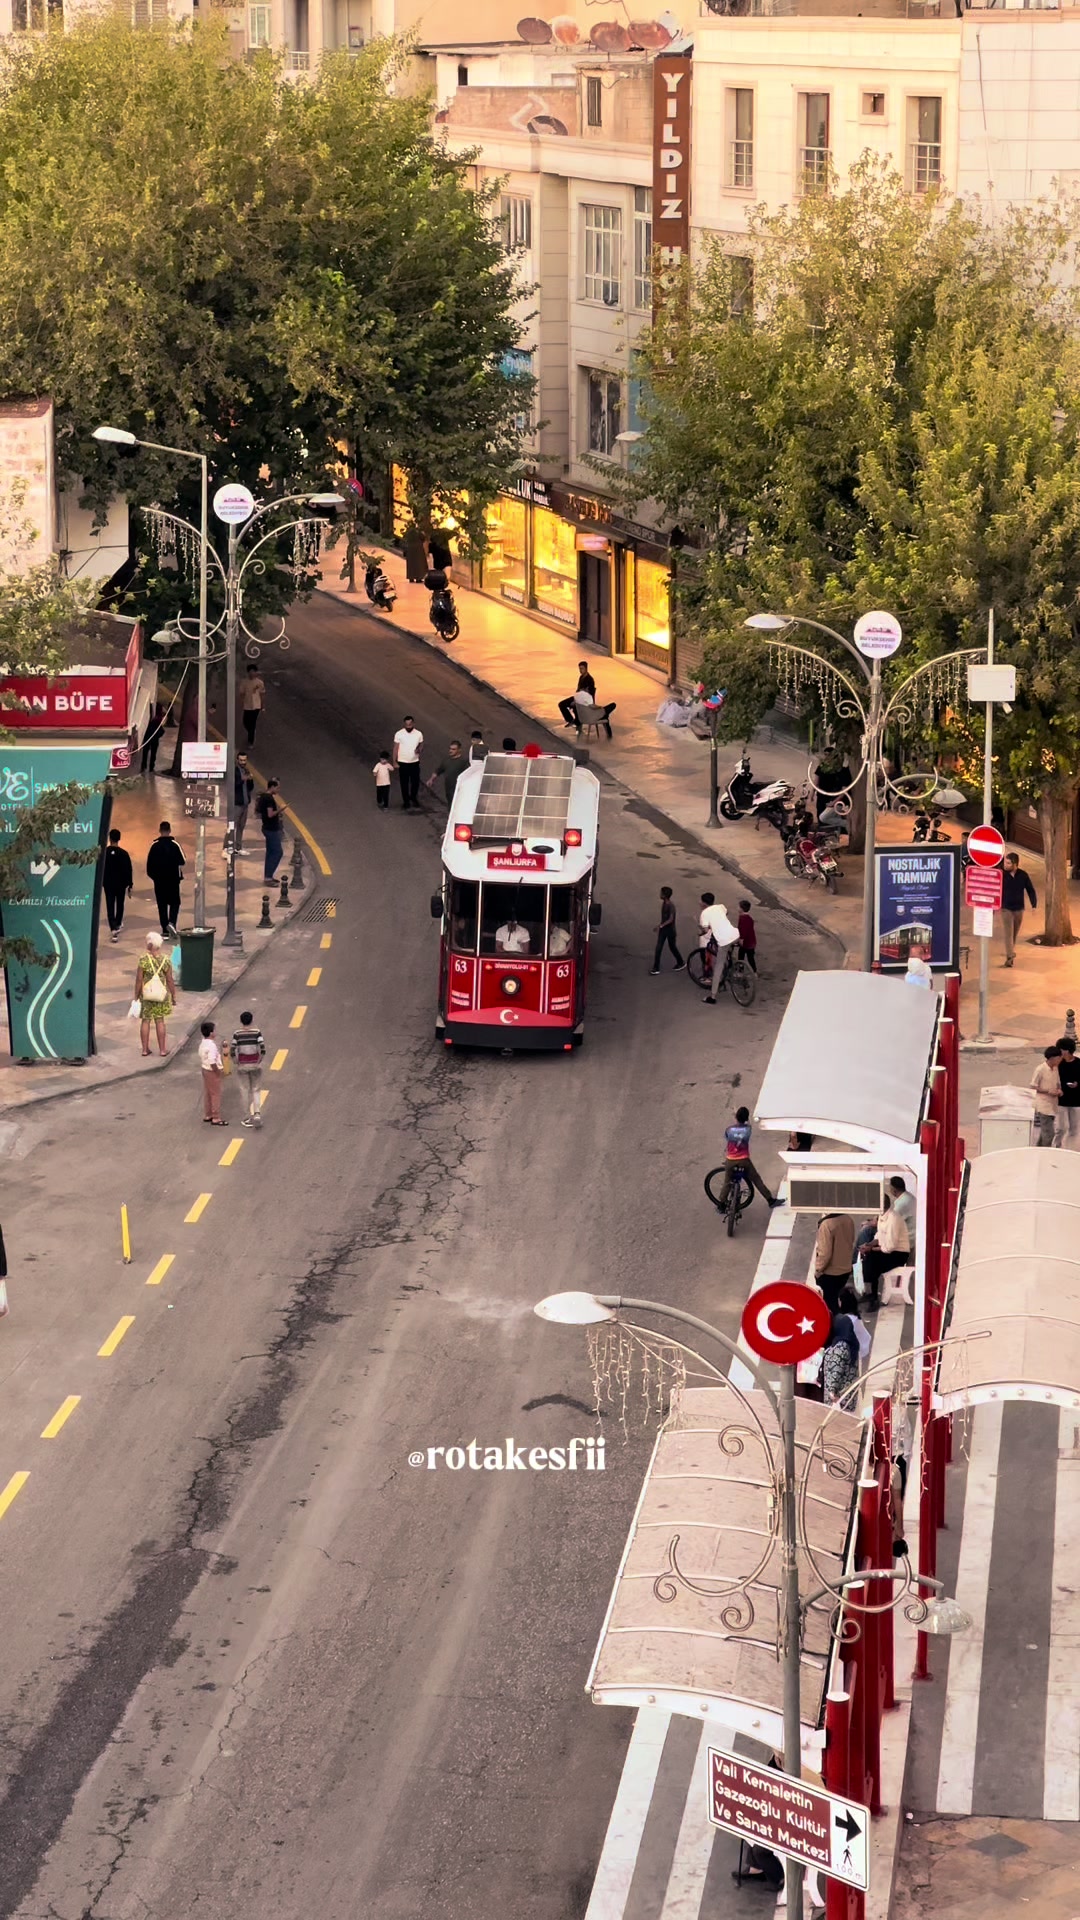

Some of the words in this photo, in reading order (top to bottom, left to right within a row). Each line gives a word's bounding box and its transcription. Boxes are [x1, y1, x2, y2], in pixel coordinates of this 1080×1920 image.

[660, 73, 684, 219] YILDIZ
[55, 691, 113, 711] BÜFE
[74, 819, 93, 834] EVİ
[888, 858, 941, 871] NOSTALJİK
[891, 871, 938, 884] TRAMVAY
[454, 959, 468, 973] 63
[556, 965, 570, 978] 63
[714, 1756, 737, 1779] Vali
[743, 1769, 813, 1811] Kemalettin
[715, 1780, 781, 1819] Gazezoğlu
[786, 1809, 827, 1838] Kültür
[714, 1801, 731, 1820] Ve
[736, 1811, 773, 1838] Sanat
[777, 1828, 829, 1862] Merkezi
